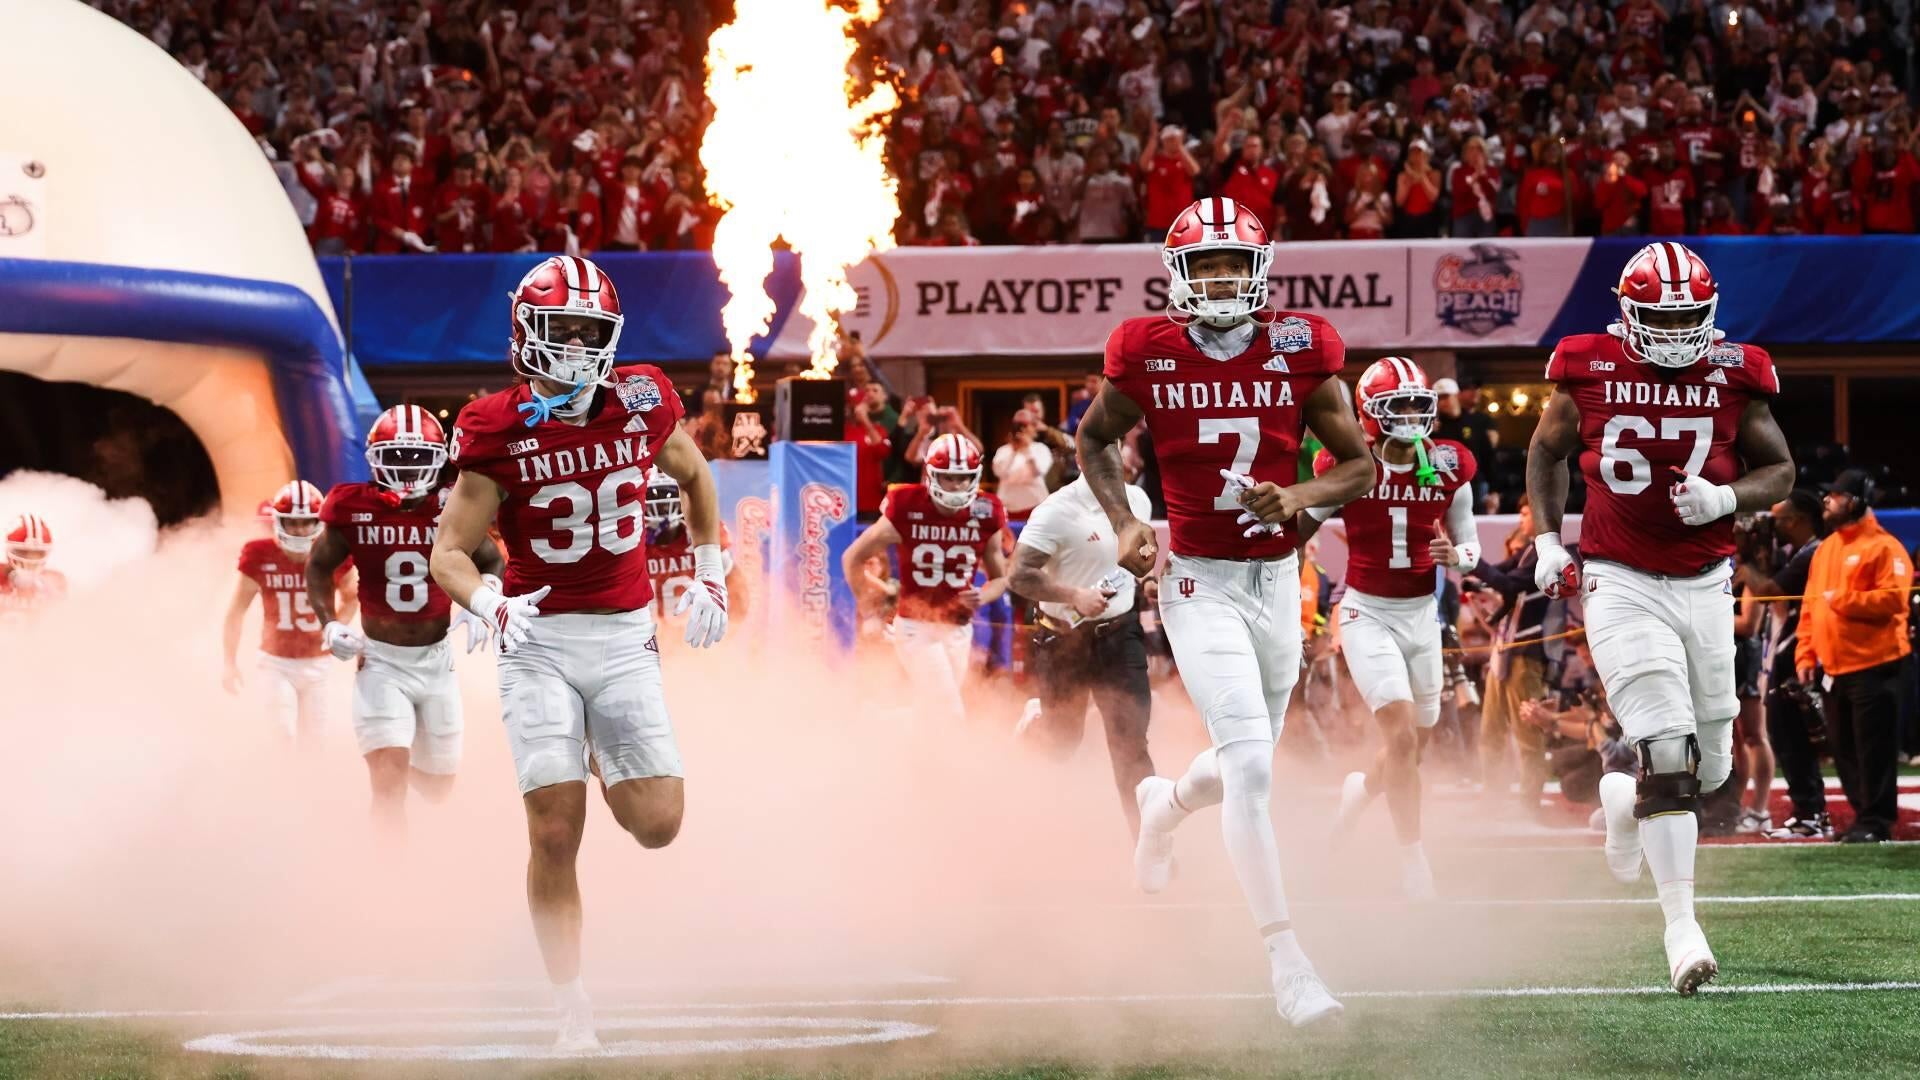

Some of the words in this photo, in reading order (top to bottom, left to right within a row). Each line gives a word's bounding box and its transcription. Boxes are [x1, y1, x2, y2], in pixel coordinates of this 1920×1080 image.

[916, 277, 1122, 316] PLAYOFF
[1437, 290, 1520, 314] PEACH
[1271, 334, 1310, 347] PEACH
[622, 389, 660, 409] PEACH
[1151, 380, 1295, 410] INDIANA
[1604, 380, 1721, 408] INDIANA
[517, 435, 651, 482] INDIANA
[1198, 416, 1261, 511] 7
[1599, 414, 1715, 496] 67
[529, 465, 646, 564] 36
[911, 524, 981, 542] INDIANA
[357, 525, 440, 545] INDIAN
[1388, 506, 1412, 569] 1
[385, 551, 429, 613] 8
[911, 543, 977, 588] 93
[275, 591, 322, 632] 15
